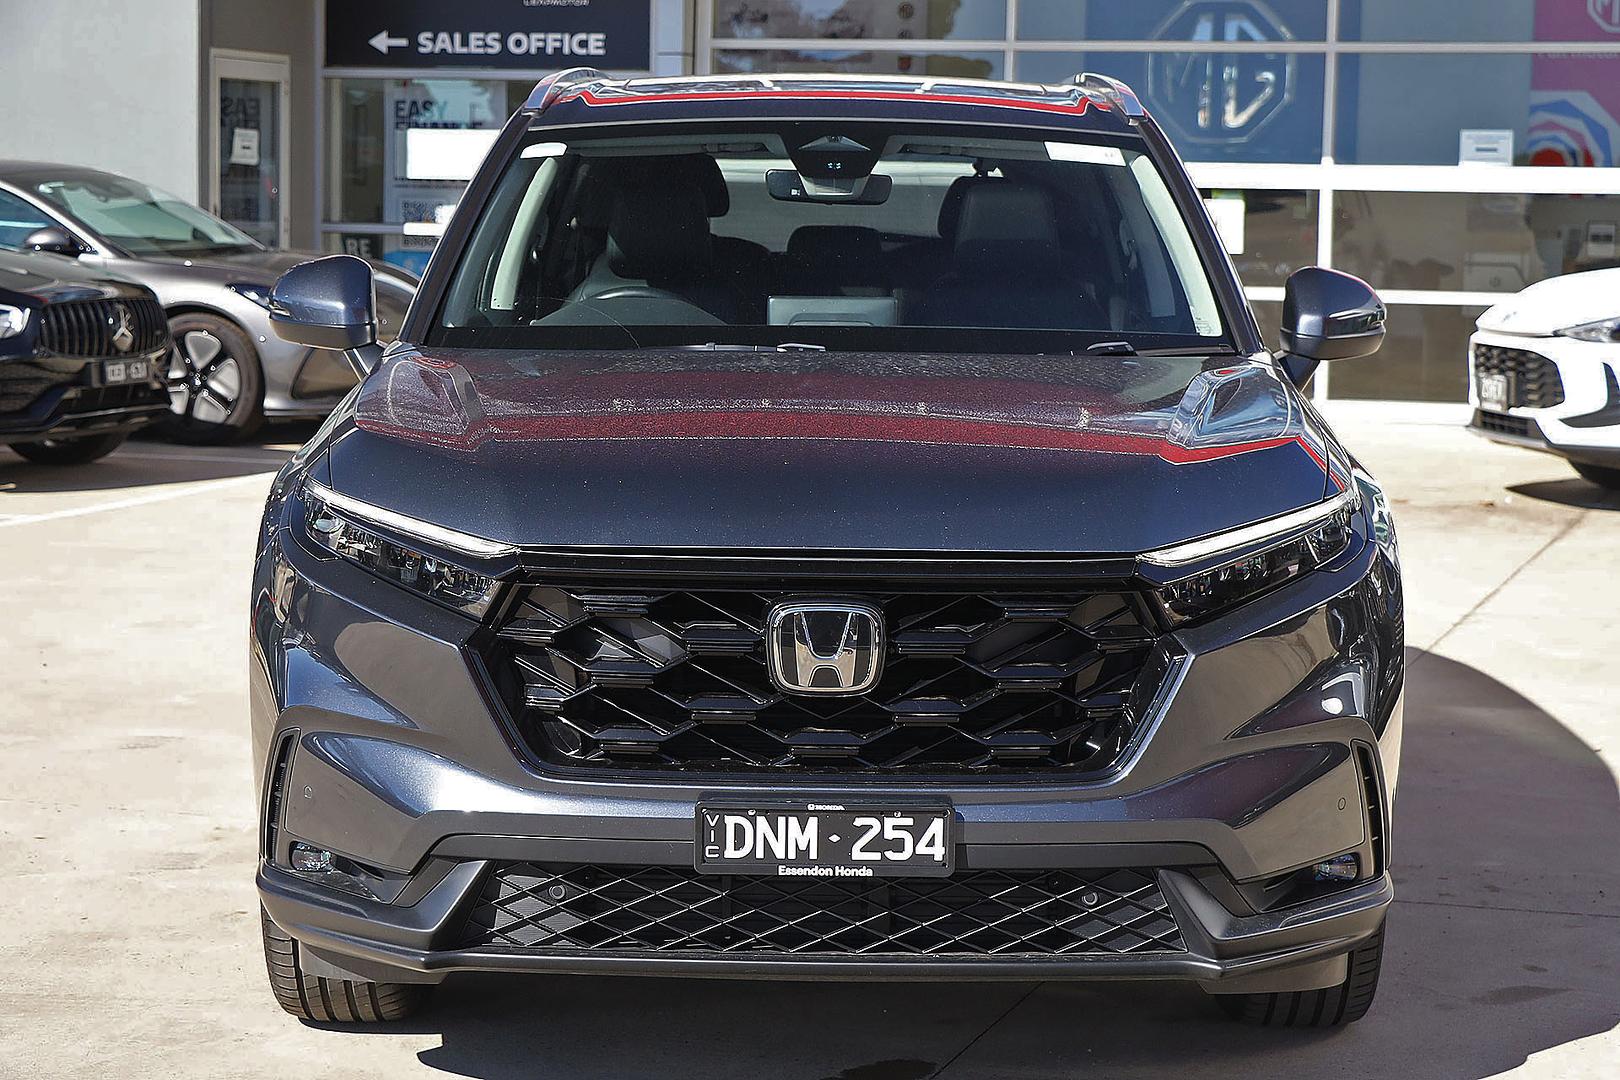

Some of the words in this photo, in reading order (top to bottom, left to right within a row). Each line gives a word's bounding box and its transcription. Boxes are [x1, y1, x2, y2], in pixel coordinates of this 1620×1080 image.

[417, 31, 502, 55] SALES
[507, 32, 607, 56] OFFICE
[395, 100, 448, 120] EASY
[705, 814, 720, 858] VIC
[723, 814, 818, 860] DNM
[851, 816, 946, 862] 254
[778, 865, 833, 877] Essendon
[835, 866, 873, 877] Honda
